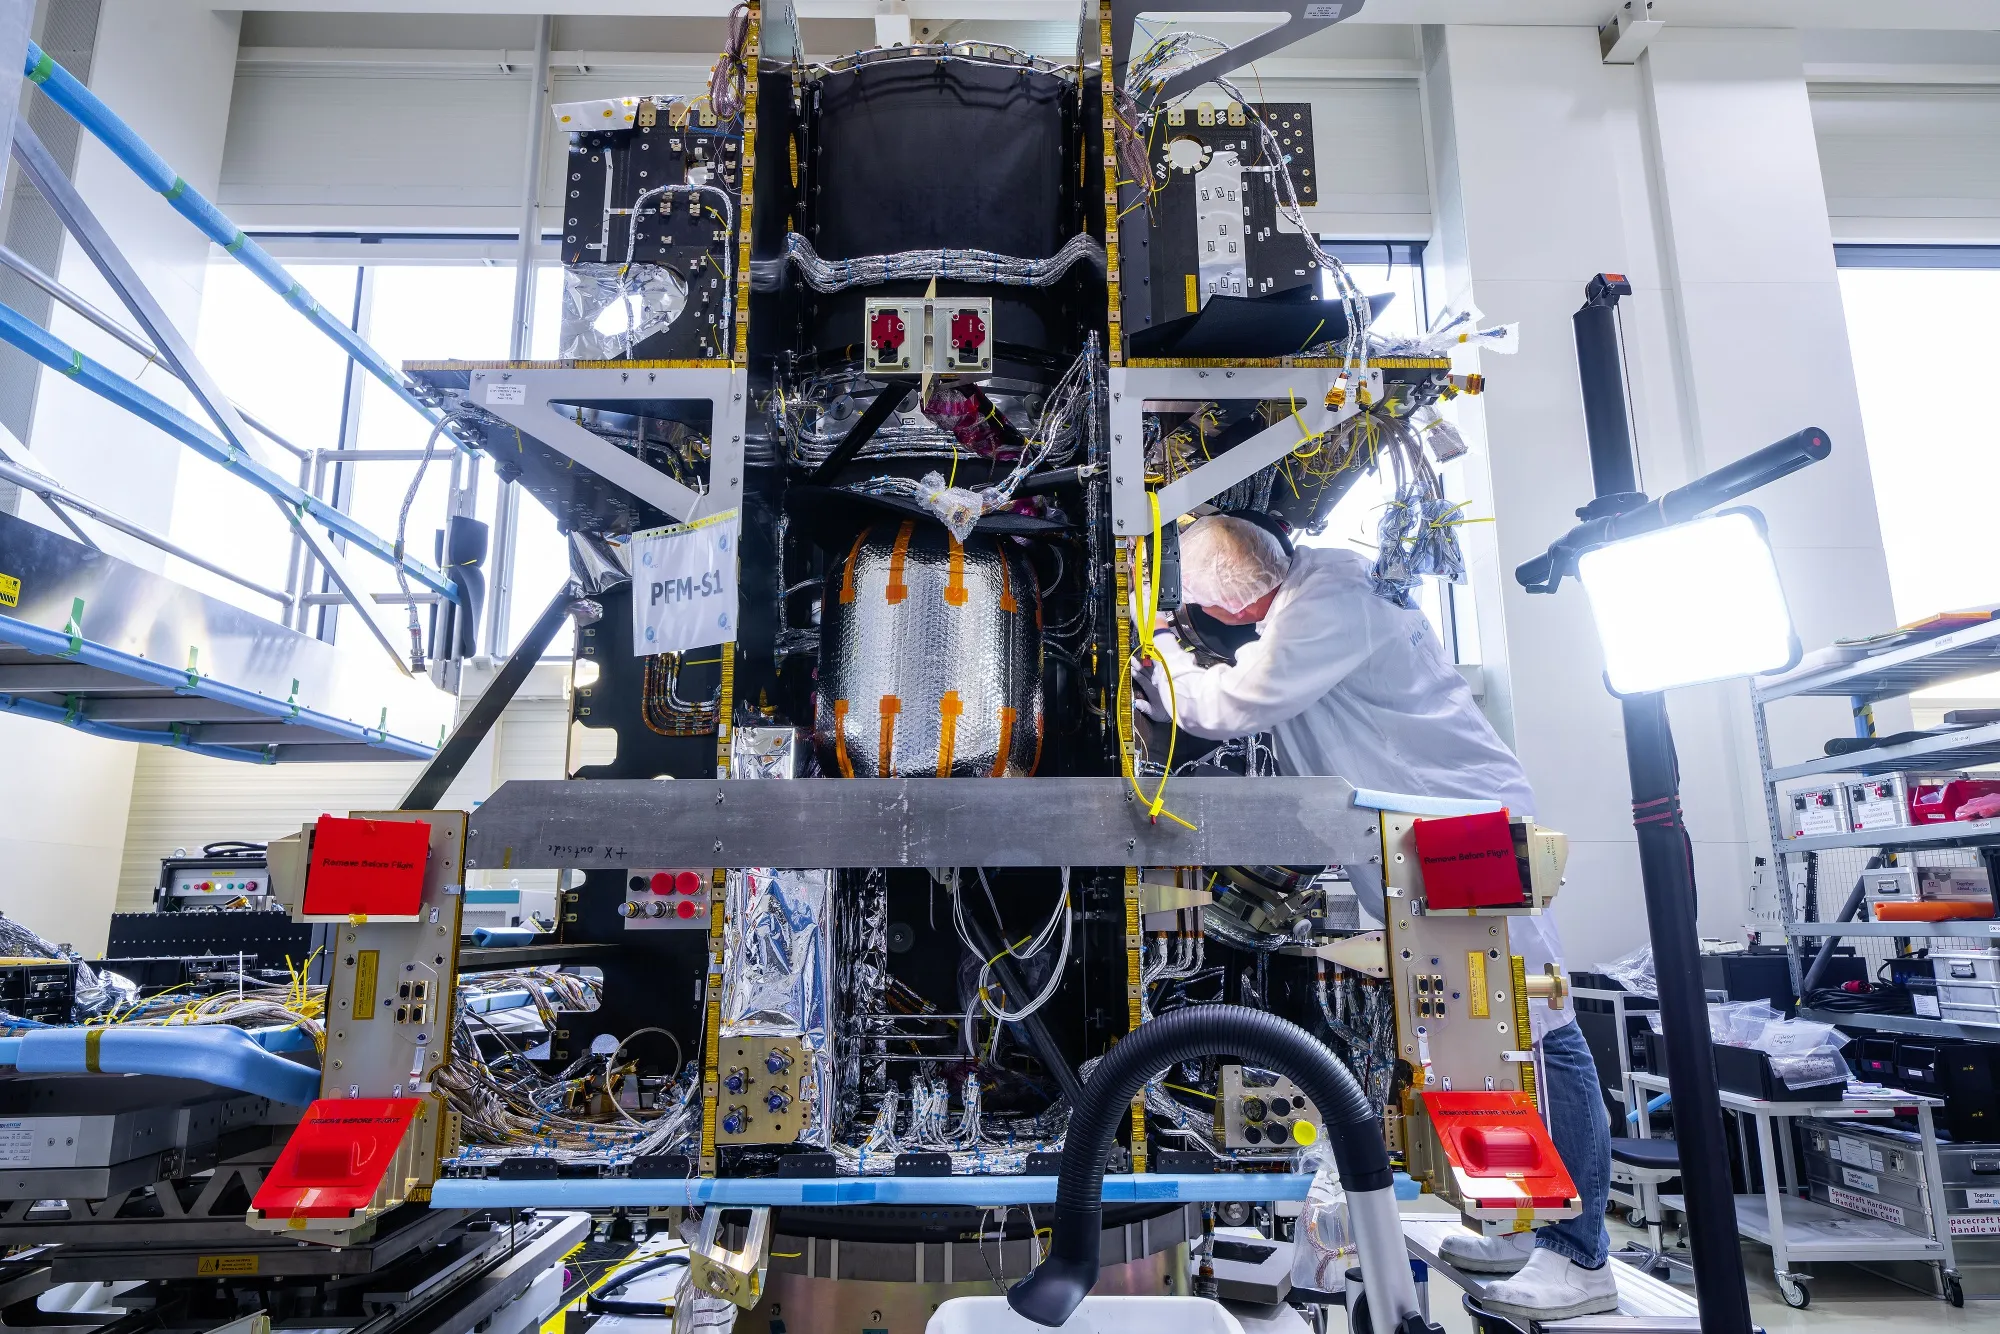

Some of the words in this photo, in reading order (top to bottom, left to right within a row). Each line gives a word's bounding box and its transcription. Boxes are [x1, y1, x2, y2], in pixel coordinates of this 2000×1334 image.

[651, 569, 723, 606] PFM-S1
[323, 858, 359, 868] Remove
[361, 860, 389, 869] Before
[391, 861, 414, 870] Flight
[1424, 855, 1456, 865] Remove
[1459, 852, 1484, 861] Before
[1486, 849, 1508, 859] Flight
[1831, 1188, 1865, 1204] Spacecraft
[1867, 1199, 1900, 1214] Hardware
[1862, 1205, 1879, 1216] with
[1951, 1225, 1986, 1233] Handle
